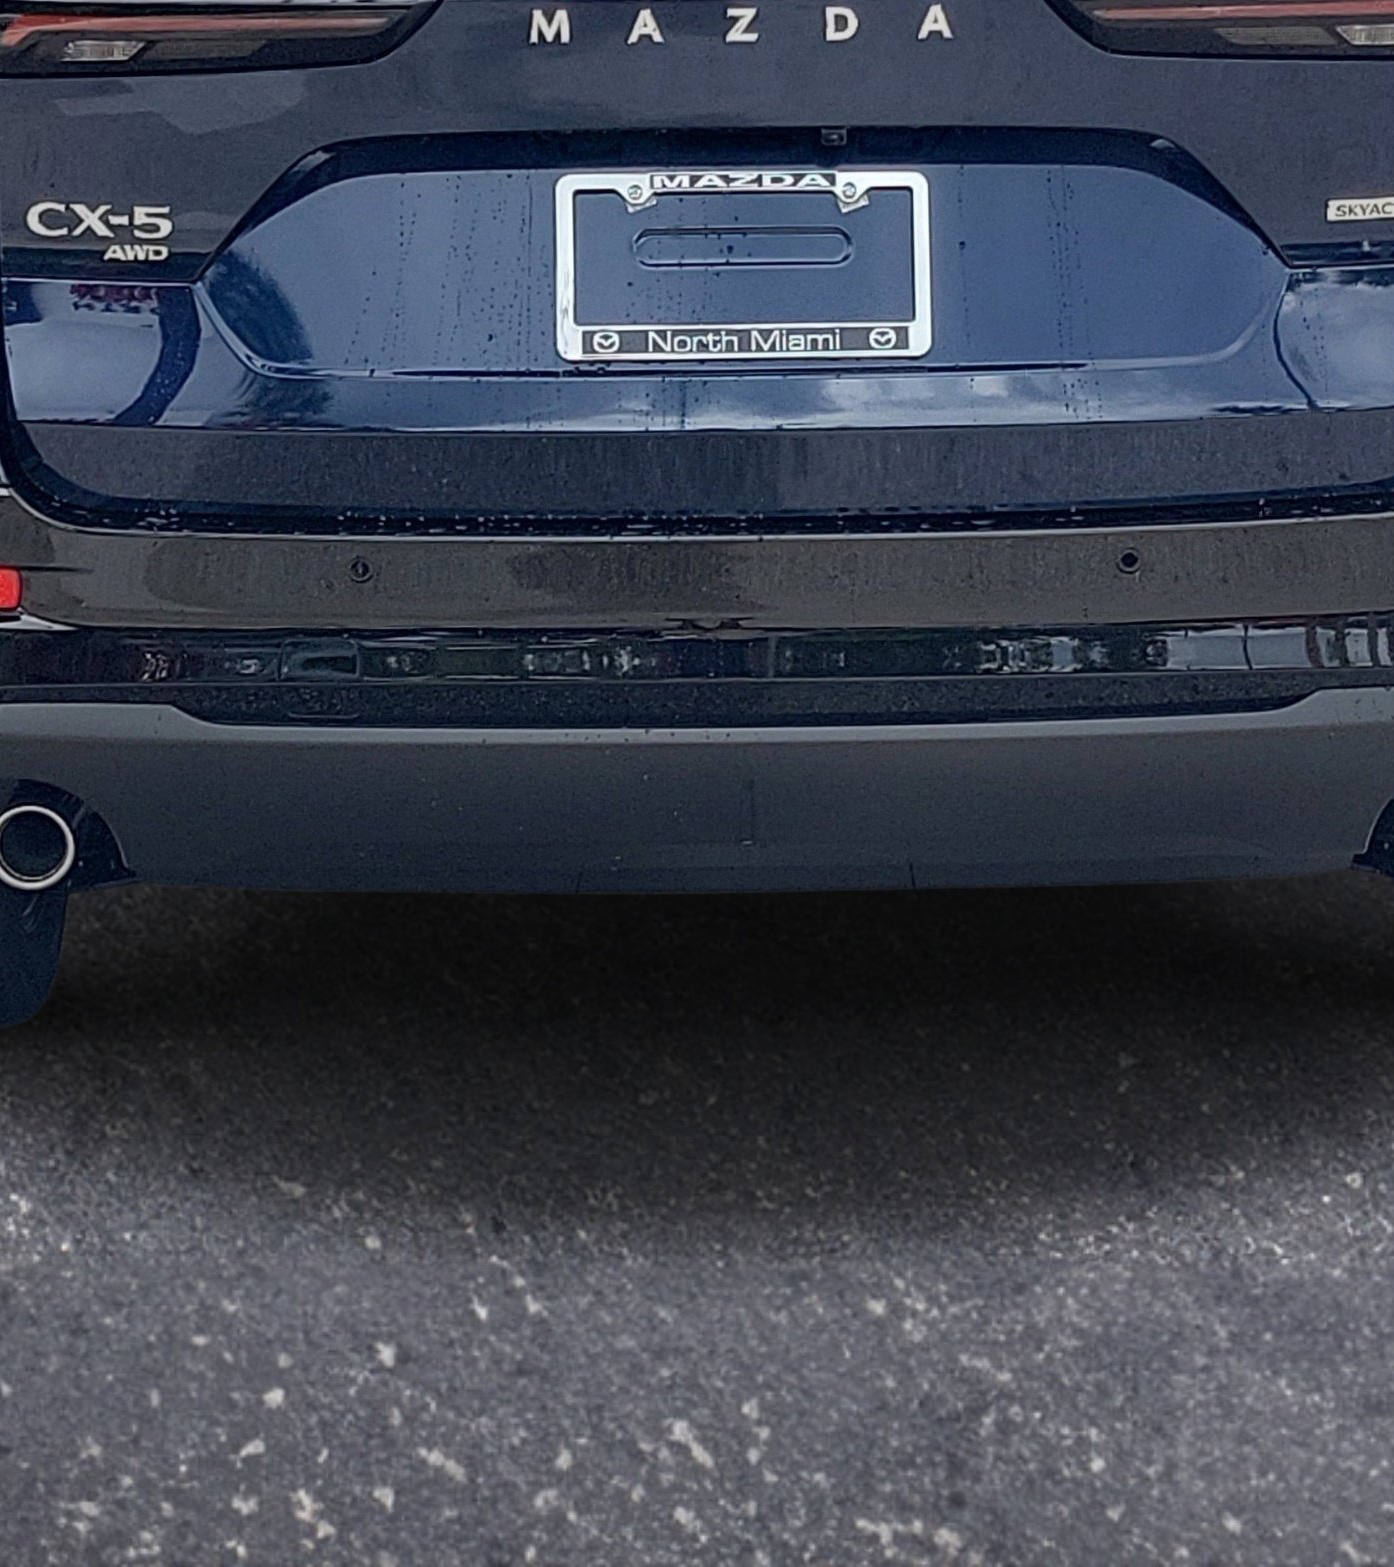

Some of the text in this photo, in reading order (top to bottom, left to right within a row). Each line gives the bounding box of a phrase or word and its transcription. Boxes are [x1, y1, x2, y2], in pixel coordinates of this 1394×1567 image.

[528, 3, 954, 45] MAZDA
[652, 172, 831, 189] MAZDA
[26, 201, 174, 239] CX-5
[103, 244, 169, 261] AWD
[647, 328, 841, 353] North Miami
